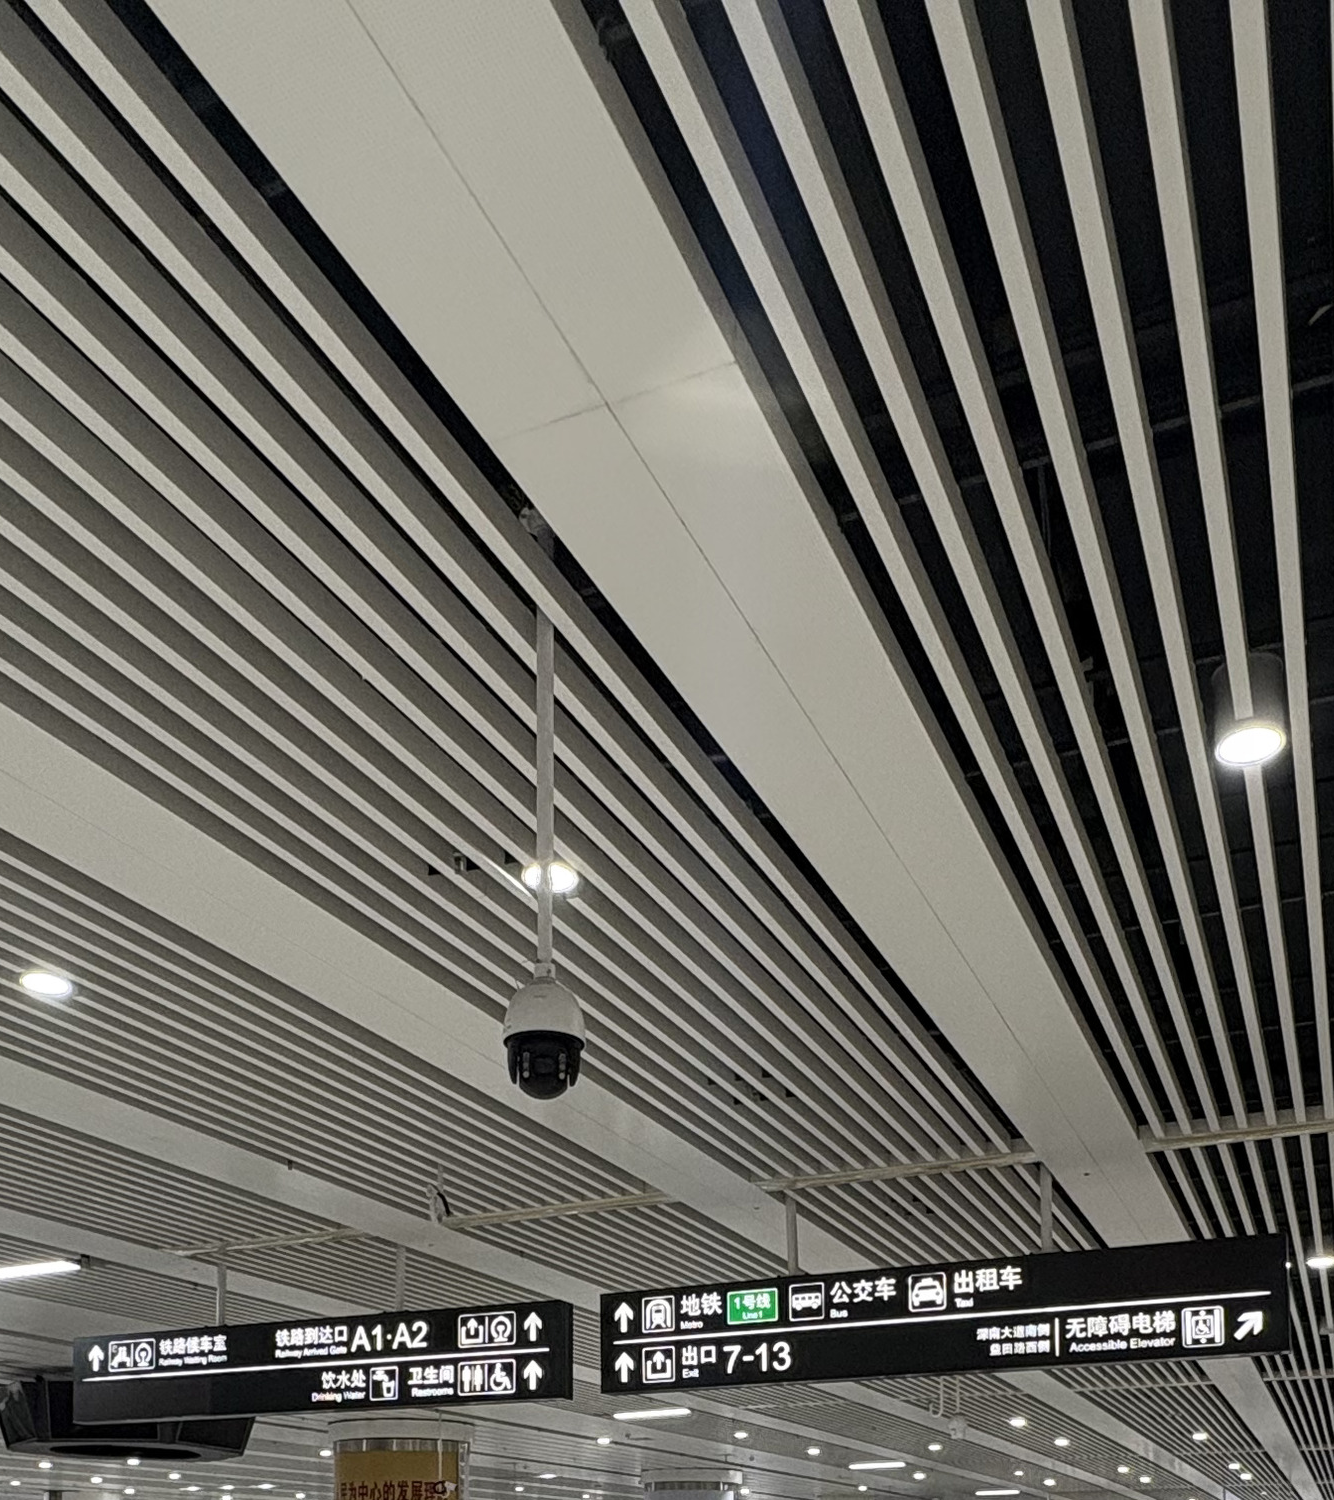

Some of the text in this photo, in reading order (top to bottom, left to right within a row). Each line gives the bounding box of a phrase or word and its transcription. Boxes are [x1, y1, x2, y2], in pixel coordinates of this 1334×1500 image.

[680, 1265, 1023, 1317] 地铁 1号线 公交车 出租车
[955, 1297, 974, 1308] Taxi
[830, 1308, 849, 1318] Bus
[680, 1320, 703, 1330] Metro
[976, 1323, 1051, 1342] 深南大道南侧
[1065, 1310, 1177, 1340] 无障碍电梯
[159, 1334, 228, 1355] 铁路候车室
[275, 1325, 348, 1347] 铁路到达口
[1069, 1336, 1176, 1353] Accessible Elevator
[159, 1356, 183, 1367] Railway
[275, 1348, 302, 1359] Railway
[681, 1341, 792, 1374] 出口 7-13
[321, 1369, 366, 1390] 饮水处
[407, 1365, 455, 1386] 卫生间
[682, 1368, 700, 1378] Exit
[311, 1390, 366, 1403] Drinking Water
[411, 1386, 454, 1398] Restrooms
